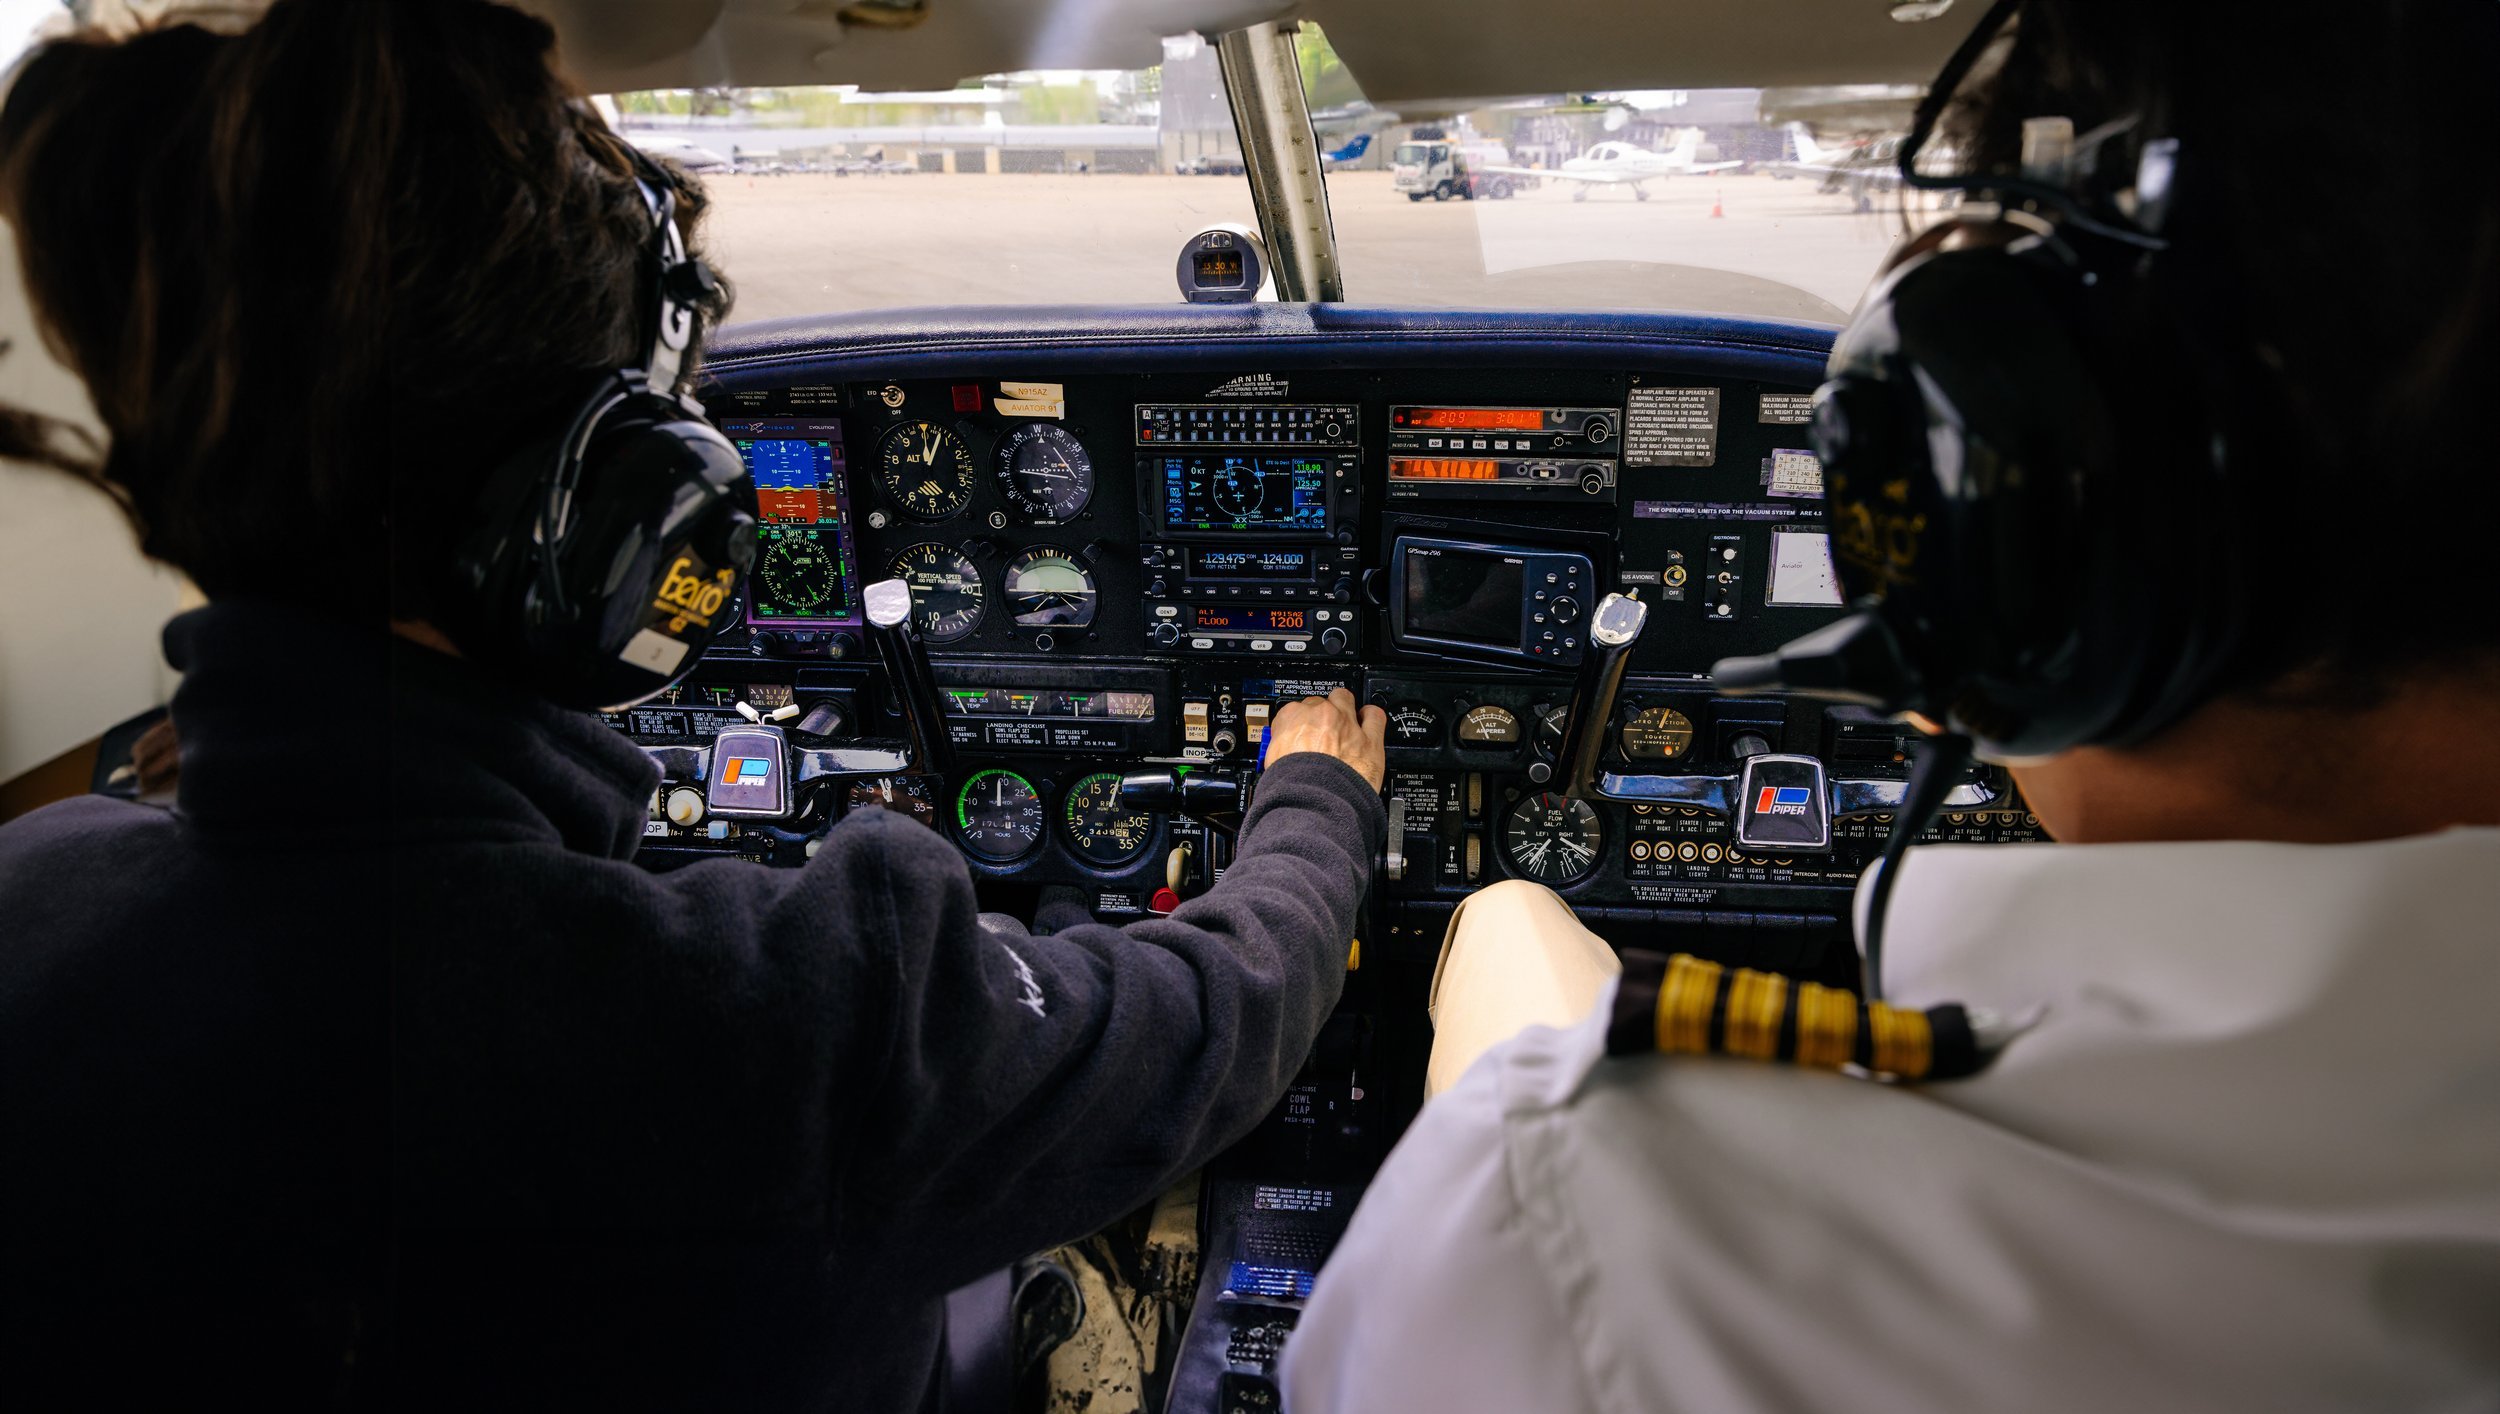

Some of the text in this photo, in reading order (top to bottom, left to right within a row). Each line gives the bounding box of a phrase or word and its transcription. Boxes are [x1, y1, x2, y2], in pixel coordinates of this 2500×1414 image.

[1227, 373, 1272, 385] ARNING
[1018, 387, 1048, 396] N915AZ
[1011, 404, 1046, 412] AVIATOR
[1439, 411, 1466, 424] 209
[1033, 424, 1042, 434] W
[1054, 428, 1065, 438] 30
[1012, 431, 1023, 442] 24
[902, 439, 911, 448] 9
[1071, 442, 1083, 452] 33
[906, 454, 921, 463] ALT
[955, 449, 963, 460] 2
[999, 448, 1010, 459] 21
[891, 455, 900, 465] 8
[892, 475, 901, 485] 7
[958, 477, 967, 487] 3
[908, 491, 916, 502] 6
[948, 491, 956, 501] 4
[929, 498, 937, 508] 5
[924, 553, 936, 564] 10
[1205, 553, 1246, 564] 129.475
[1263, 553, 1304, 565] 124.000
[1504, 557, 1523, 565] GARMIN
[917, 572, 943, 580] VERTICAL
[960, 585, 974, 595] 20
[927, 611, 941, 622] 10
[1270, 617, 1304, 628] 1200
[1185, 749, 1206, 757] INOP
[866, 784, 875, 793] 15
[907, 786, 920, 796] 30
[977, 782, 987, 790] 15
[1090, 783, 1102, 795] 15
[1014, 788, 1025, 797] 25
[967, 797, 978, 806] 10
[1077, 797, 1090, 808] 10
[913, 802, 926, 812] 35
[1771, 804, 1806, 816] PIPER
[1022, 808, 1034, 817] 30
[1076, 815, 1084, 826] 5
[1128, 816, 1143, 827] 30
[1019, 825, 1030, 833] 35
[1874, 825, 1890, 833] PITCH
[1083, 837, 1091, 848] 0
[1118, 838, 1134, 850] 35
[1289, 1094, 1311, 1104] COWL
[1289, 1105, 1311, 1115] FLAP
